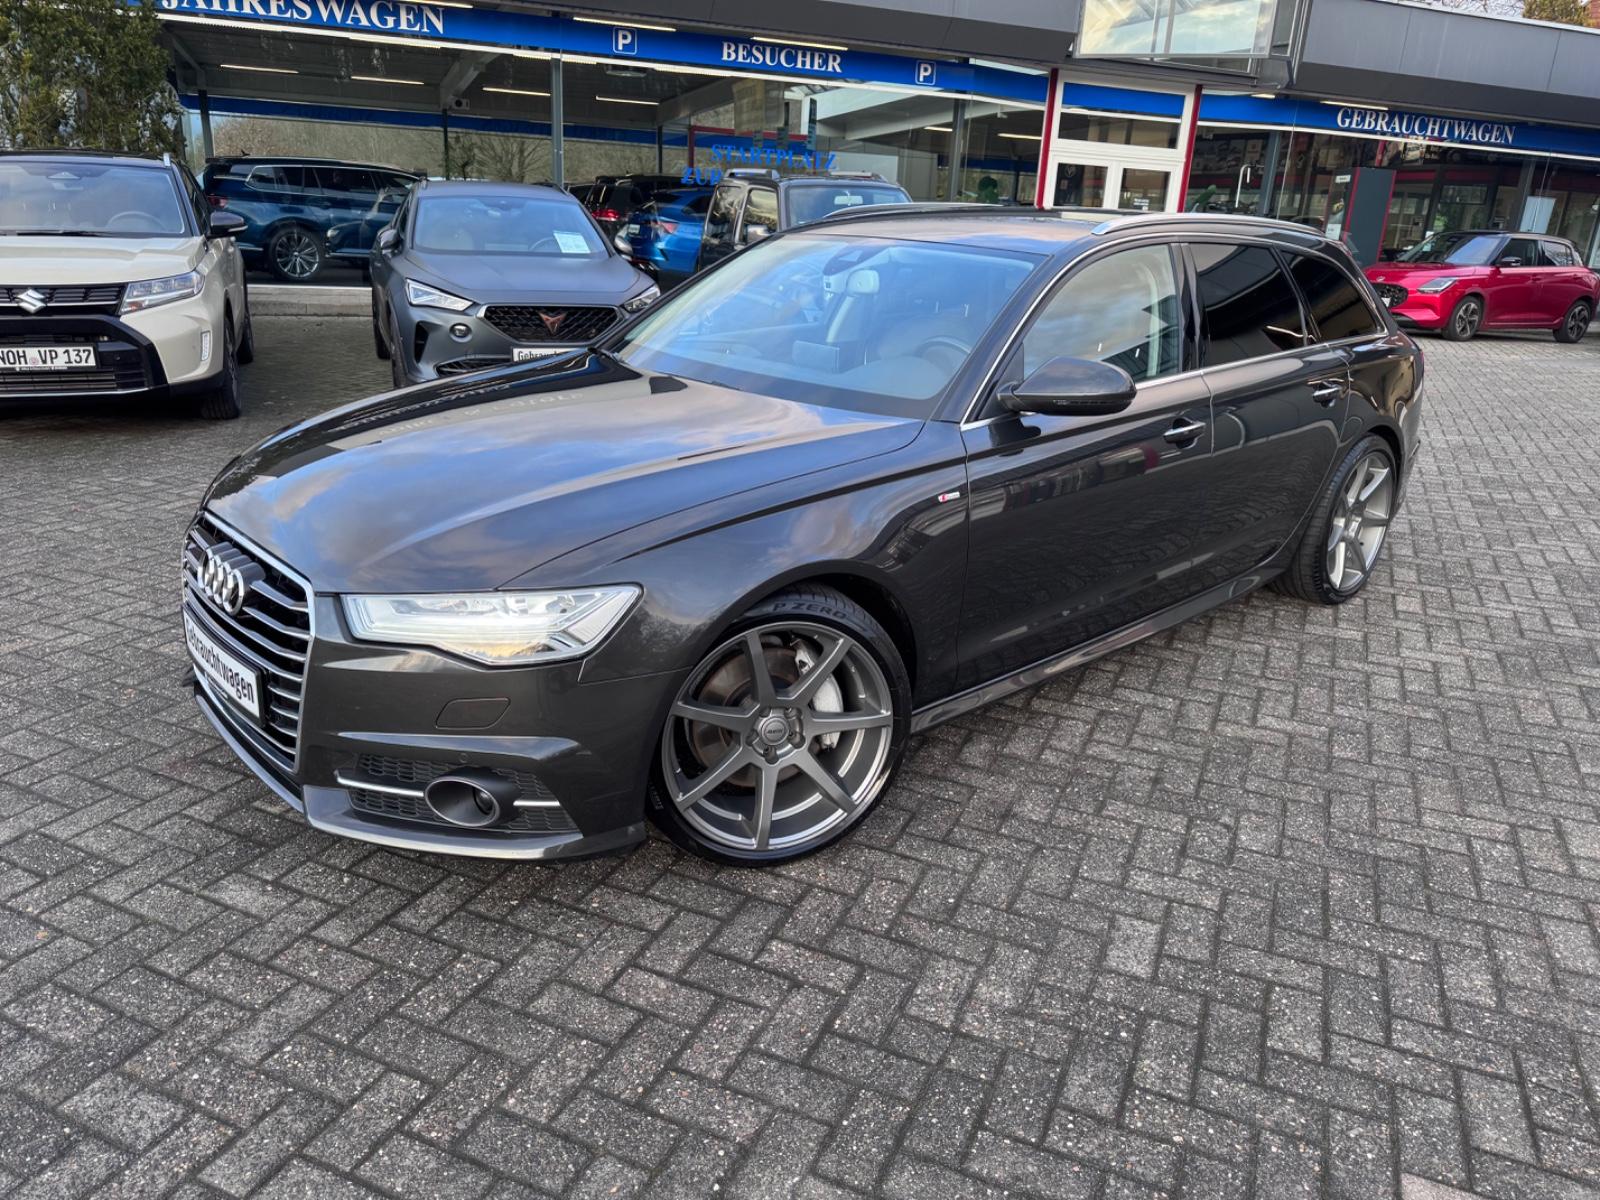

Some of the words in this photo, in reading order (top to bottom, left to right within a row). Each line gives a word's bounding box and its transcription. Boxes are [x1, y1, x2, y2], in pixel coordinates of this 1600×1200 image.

[618, 30, 632, 50] P
[721, 41, 843, 73] BESUCHER
[919, 63, 932, 81] P
[1336, 107, 1516, 145] GEBRAUCHTWAGEN
[37, 349, 58, 364] VP
[62, 349, 92, 364] 137
[791, 602, 847, 619] ZERO
[185, 617, 255, 703] Gebrauchtwagen
